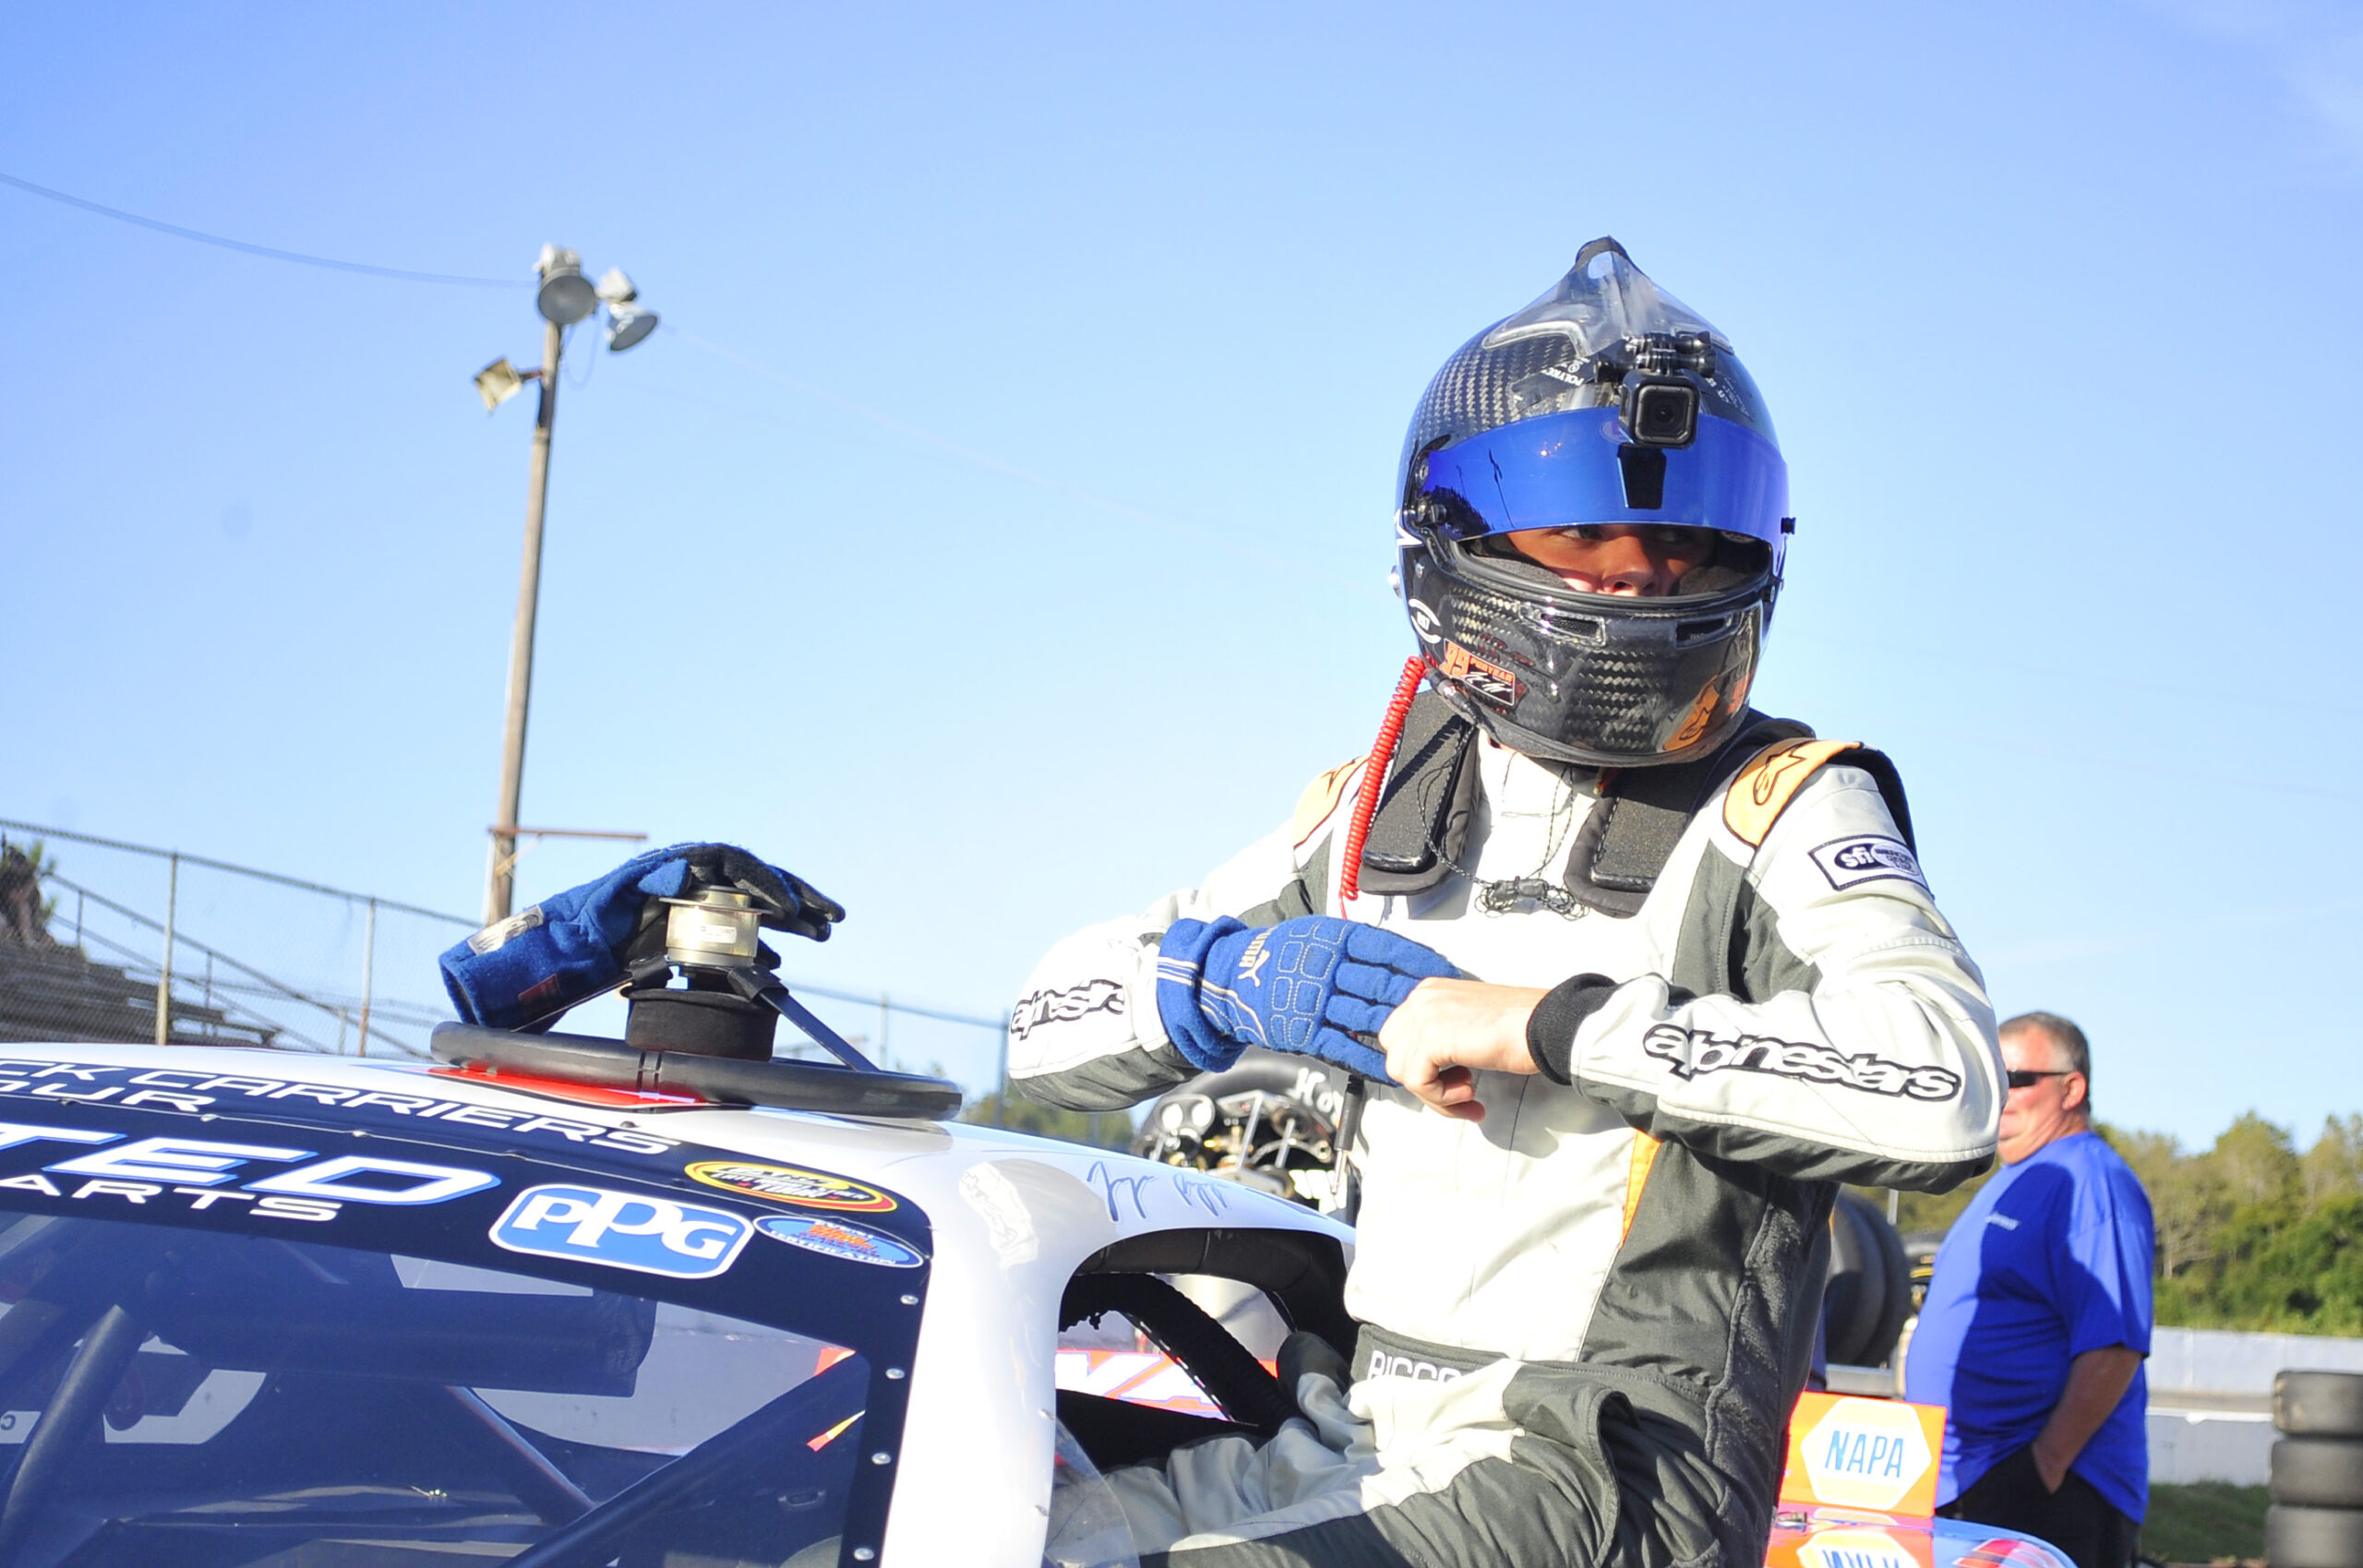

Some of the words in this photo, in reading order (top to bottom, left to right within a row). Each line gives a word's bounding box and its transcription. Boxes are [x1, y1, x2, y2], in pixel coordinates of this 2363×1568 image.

[1440, 640, 1471, 679] 99
[127, 1069, 681, 1155] CARRIERS
[0, 1174, 343, 1222] ARTS
[511, 1188, 738, 1261] PPG
[1825, 1430, 1904, 1478] NAPA
